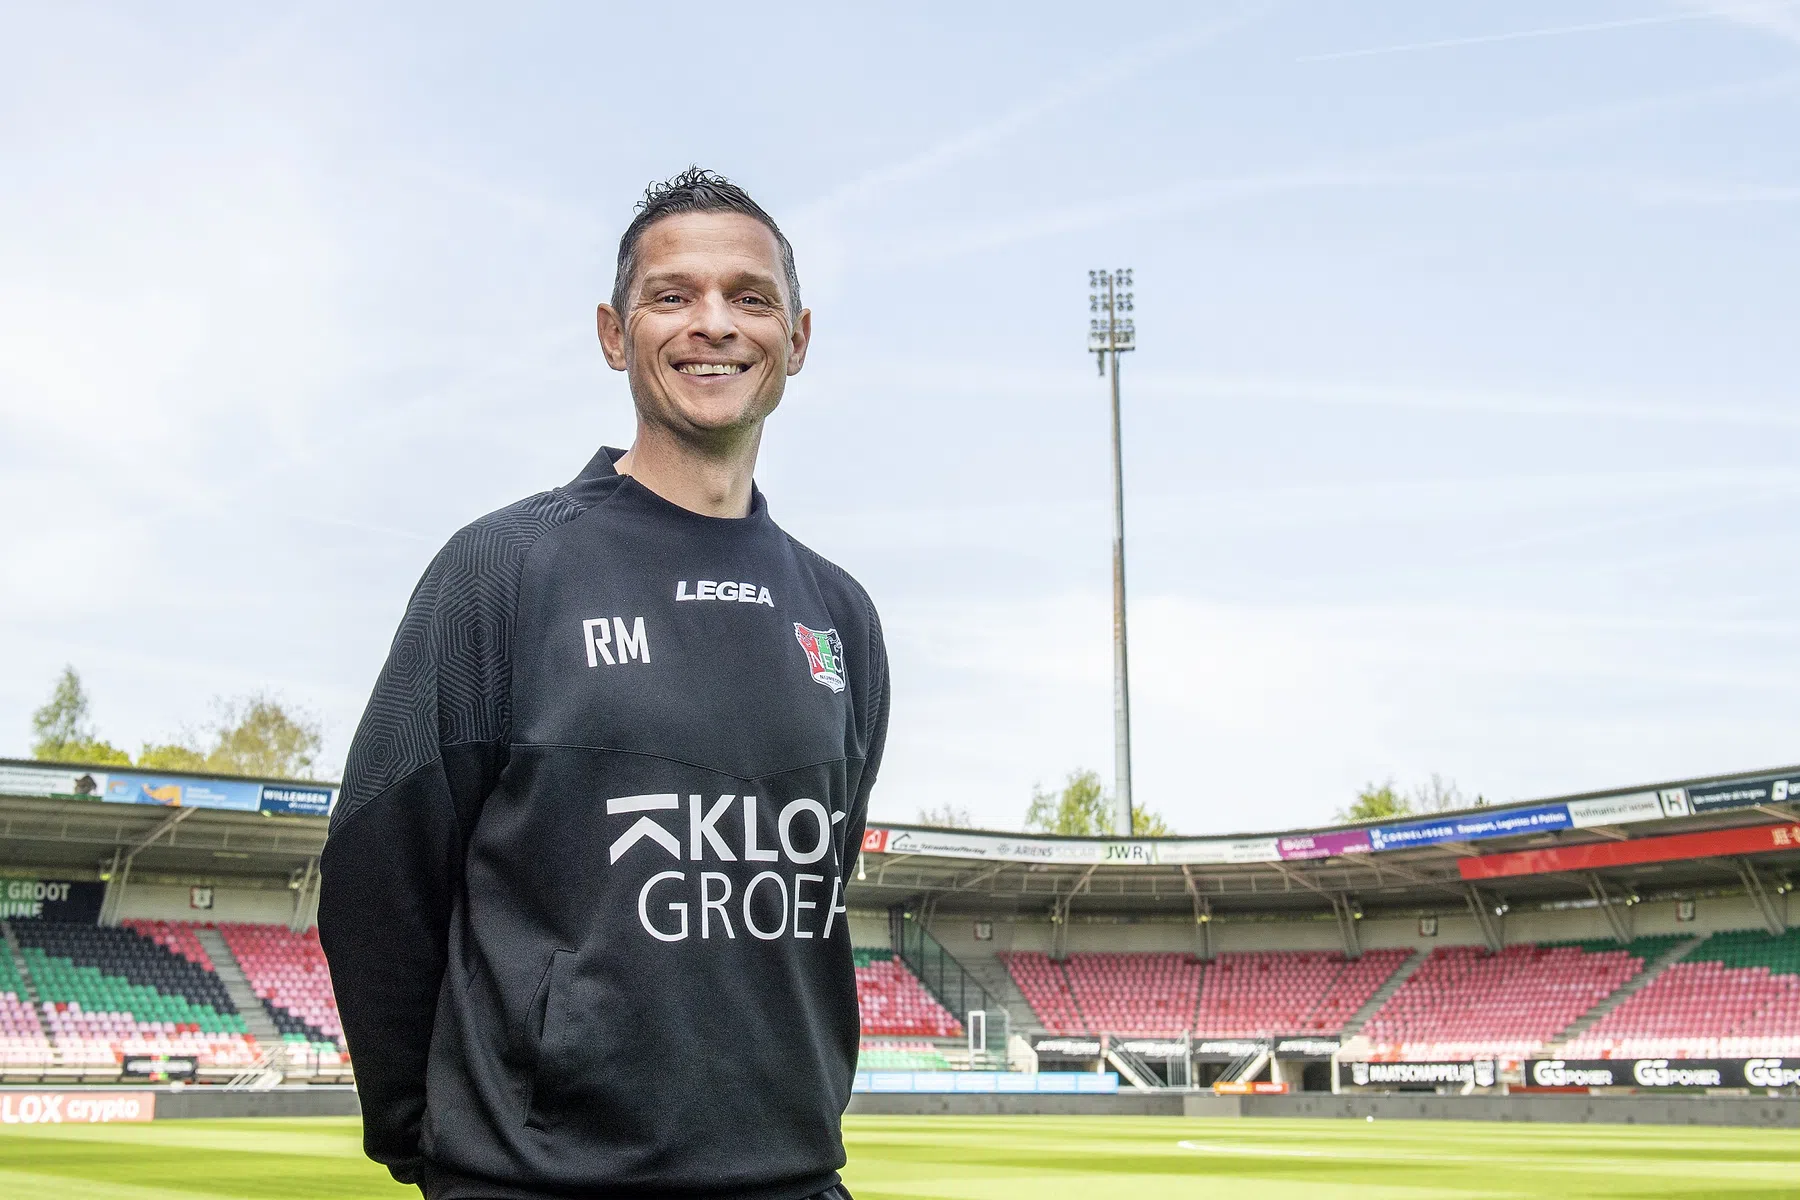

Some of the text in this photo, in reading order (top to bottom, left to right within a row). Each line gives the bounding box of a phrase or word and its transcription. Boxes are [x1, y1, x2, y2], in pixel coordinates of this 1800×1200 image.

[675, 580, 775, 608] LEGEA
[582, 616, 651, 667] RM
[1105, 845, 1143, 859] JWR
[8, 881, 72, 901] GROOT
[2, 1094, 140, 1124] LOX crypto
